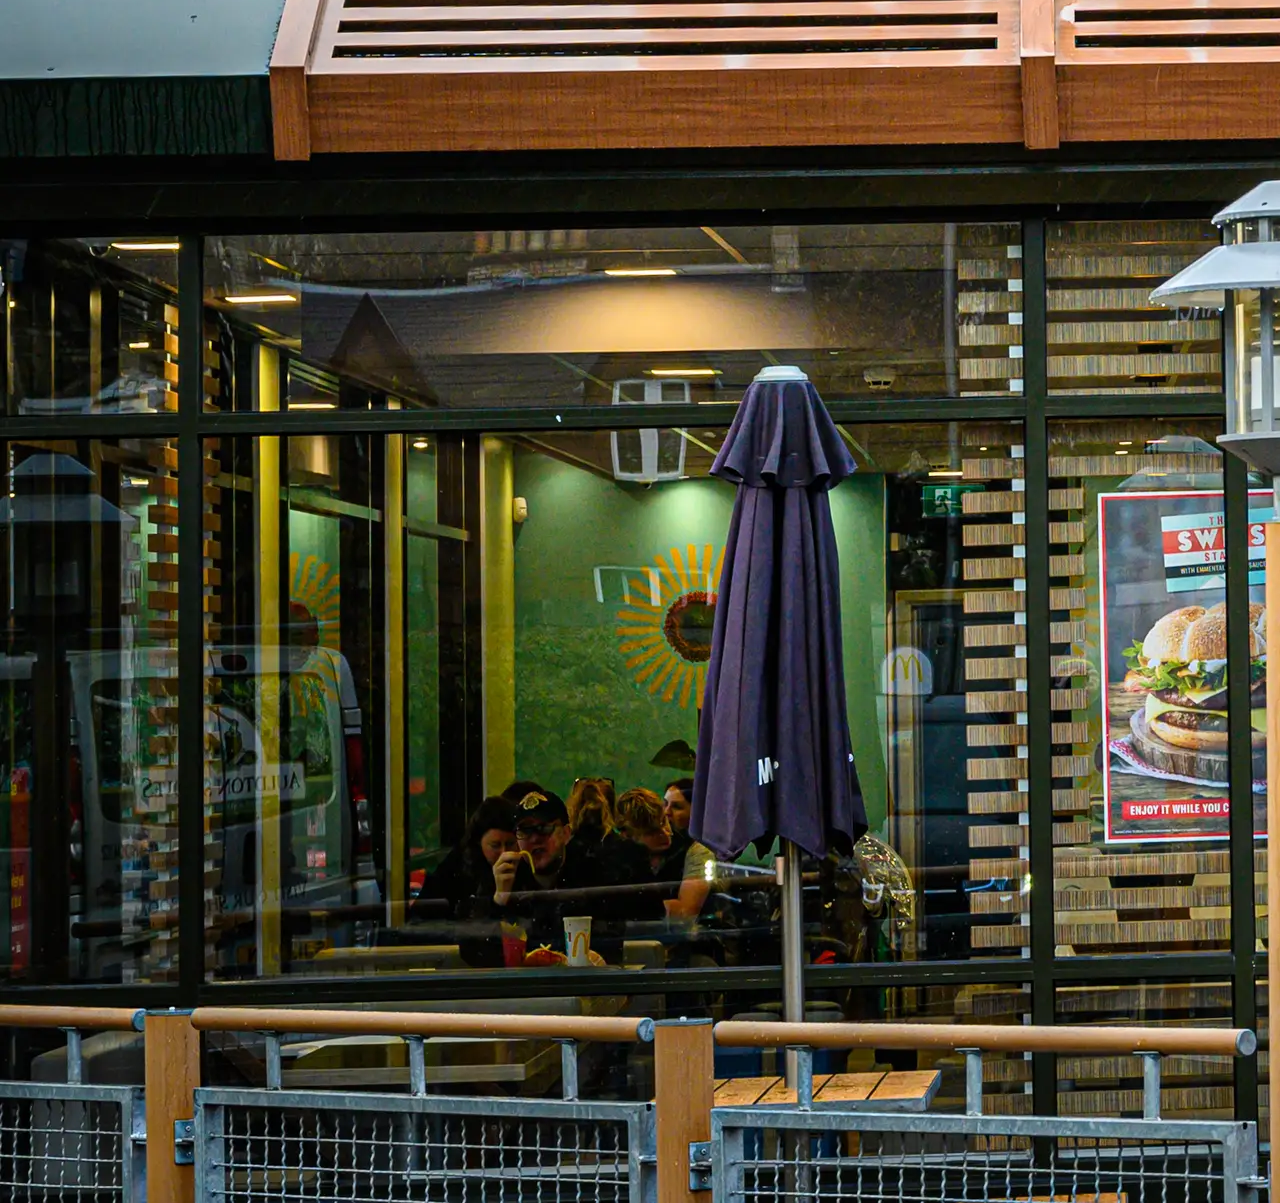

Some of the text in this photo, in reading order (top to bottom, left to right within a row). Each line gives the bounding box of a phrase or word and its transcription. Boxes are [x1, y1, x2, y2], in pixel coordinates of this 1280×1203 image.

[1208, 516, 1224, 526] TH
[1130, 805, 1159, 816] ENJOY
[1161, 804, 1170, 815] IT
[1172, 803, 1200, 814] WHILE
[1202, 803, 1222, 814] YOU
